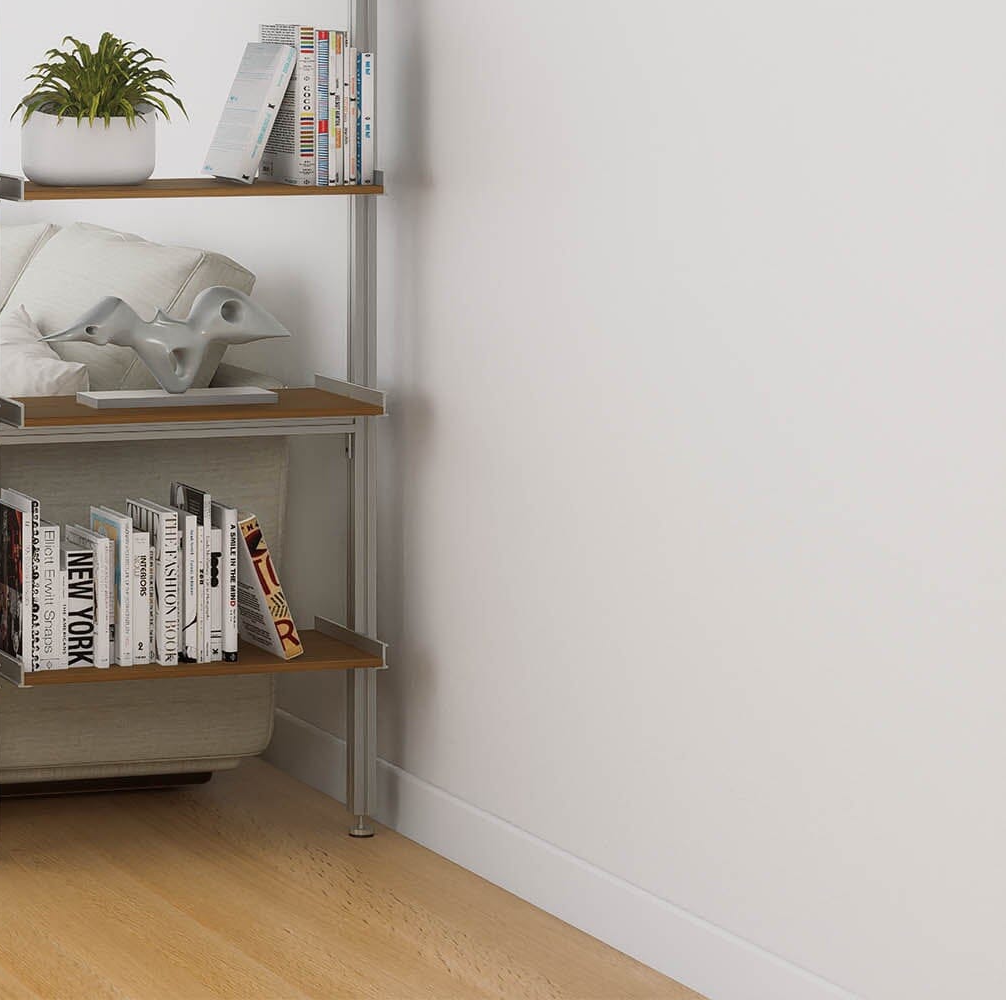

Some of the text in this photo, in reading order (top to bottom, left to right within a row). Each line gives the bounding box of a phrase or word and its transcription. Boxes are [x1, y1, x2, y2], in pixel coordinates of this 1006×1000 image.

[43, 530, 55, 654] Elliott Erwitt Snaps
[67, 552, 94, 666] NEW YORK
[164, 513, 177, 662] THE FASHION BOOK
[230, 558, 236, 566] IN
[138, 642, 144, 650] 2
